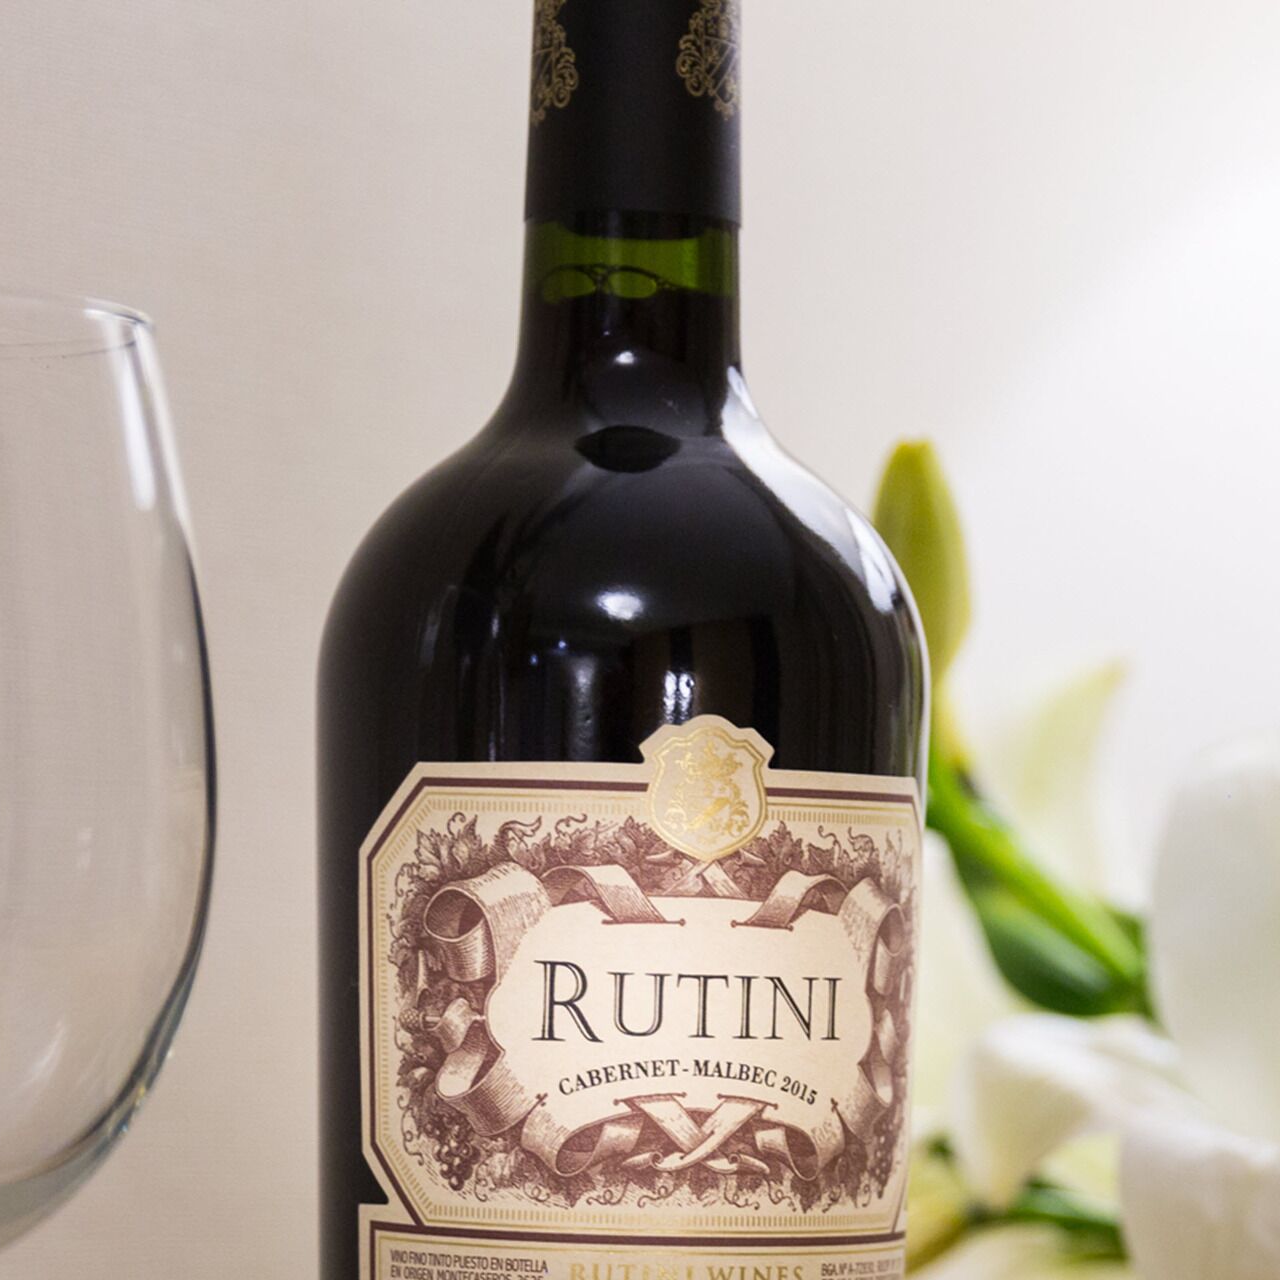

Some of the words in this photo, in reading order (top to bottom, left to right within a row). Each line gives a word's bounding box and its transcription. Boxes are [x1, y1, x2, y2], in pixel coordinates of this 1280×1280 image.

[531, 959, 843, 1043] RUTINI
[780, 1075, 819, 1106] 2015
[390, 1264, 401, 1279] EN
[409, 1250, 427, 1266] FINO
[428, 1252, 452, 1268] TINTO
[453, 1254, 489, 1271] PUESTO
[490, 1257, 504, 1271] EN
[505, 1258, 548, 1274] BOTELLA
